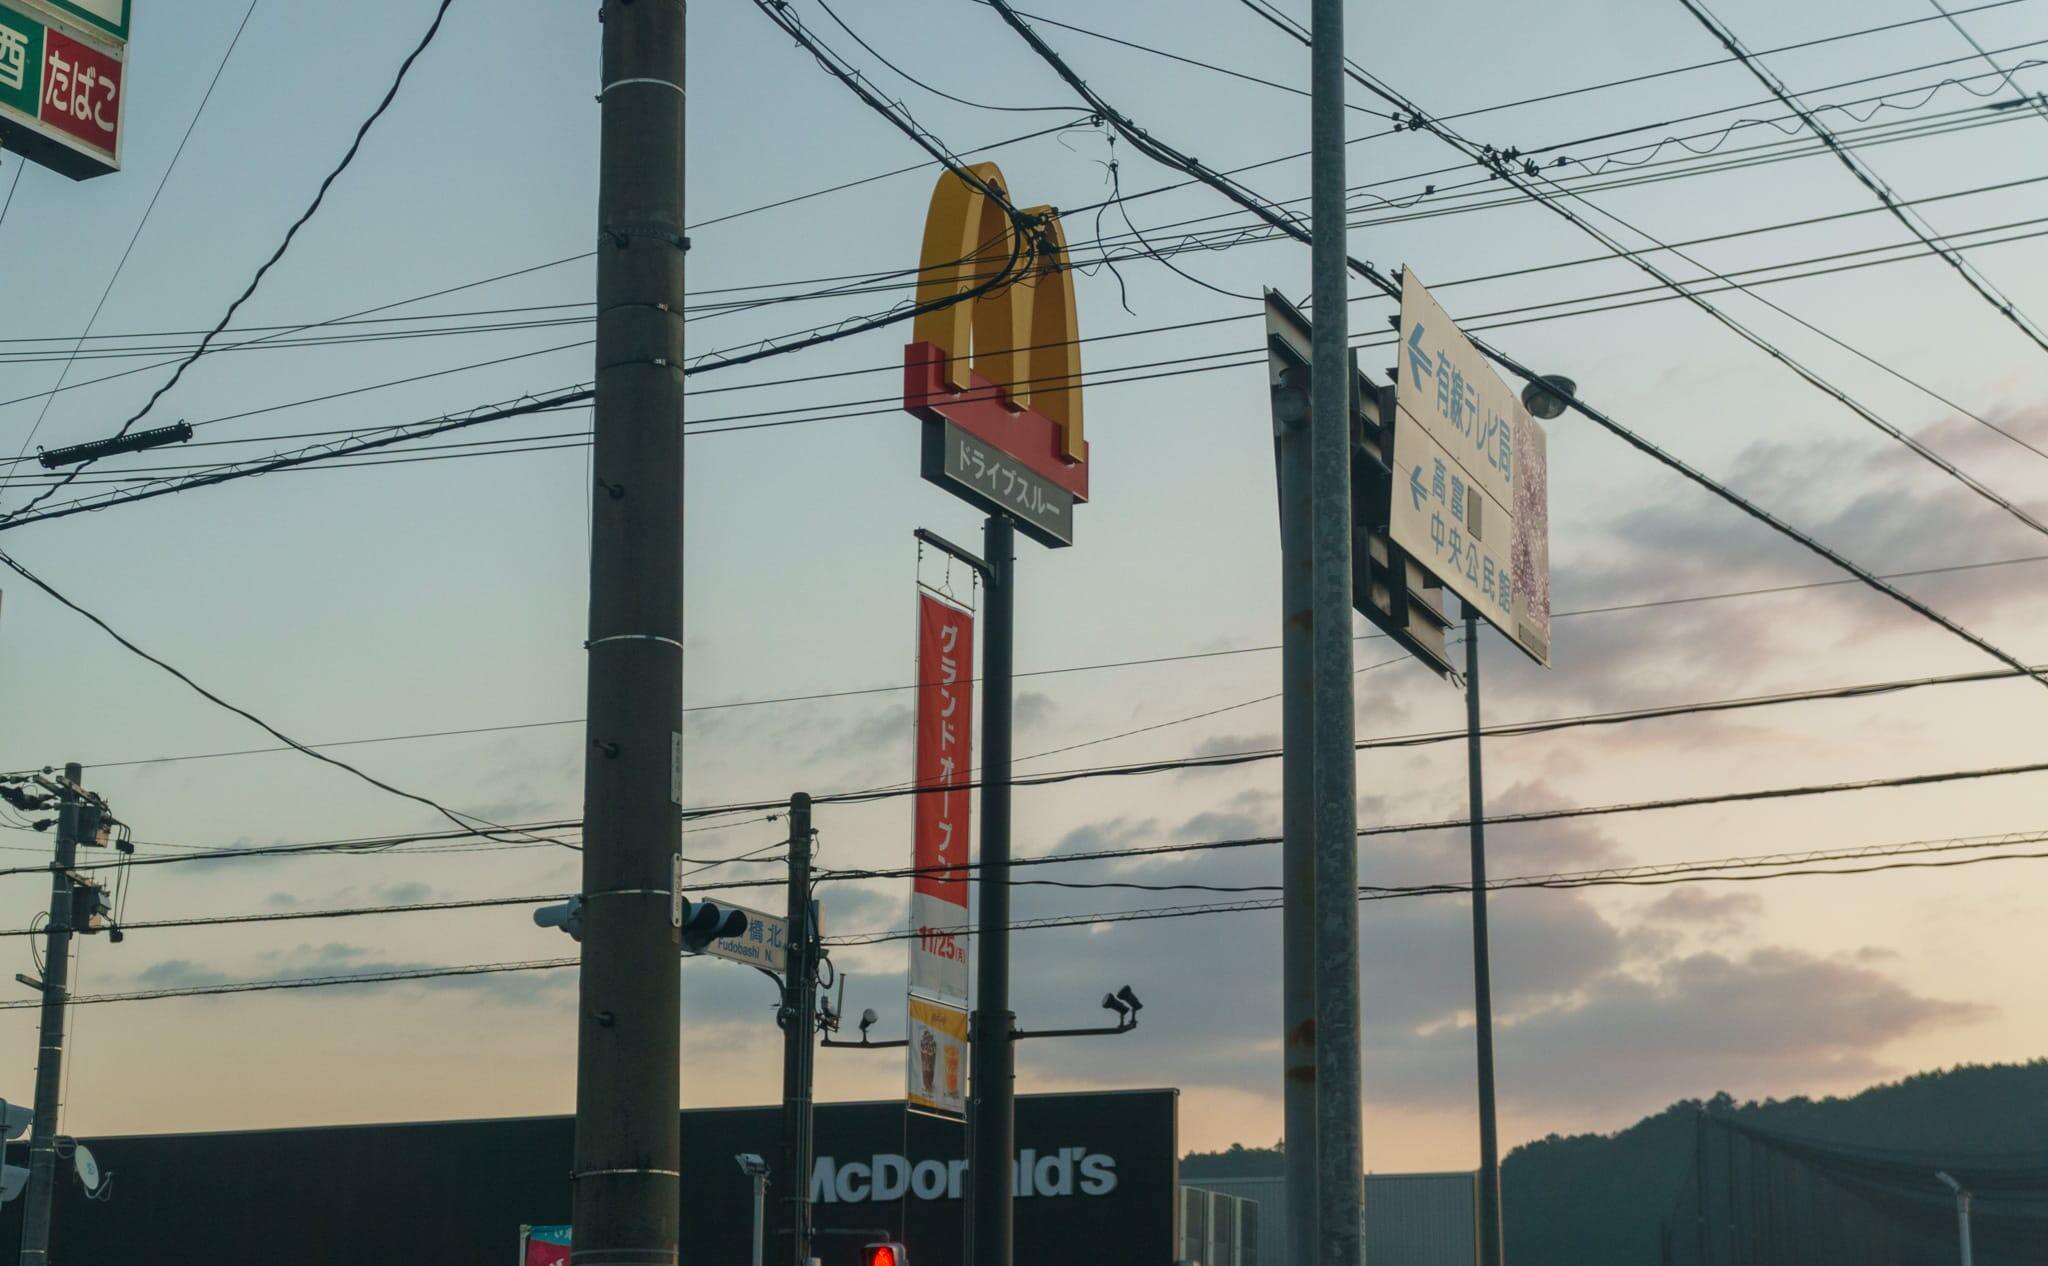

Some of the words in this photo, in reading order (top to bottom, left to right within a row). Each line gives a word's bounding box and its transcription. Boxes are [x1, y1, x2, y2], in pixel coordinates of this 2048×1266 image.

[45, 50, 116, 133] たばこ
[959, 440, 1061, 516] ドライブスルー
[1430, 511, 1511, 615] 中央公民館
[937, 624, 959, 885] グランドオープン
[749, 918, 783, 948] 橋北
[809, 1147, 1118, 1203] McDonld's
